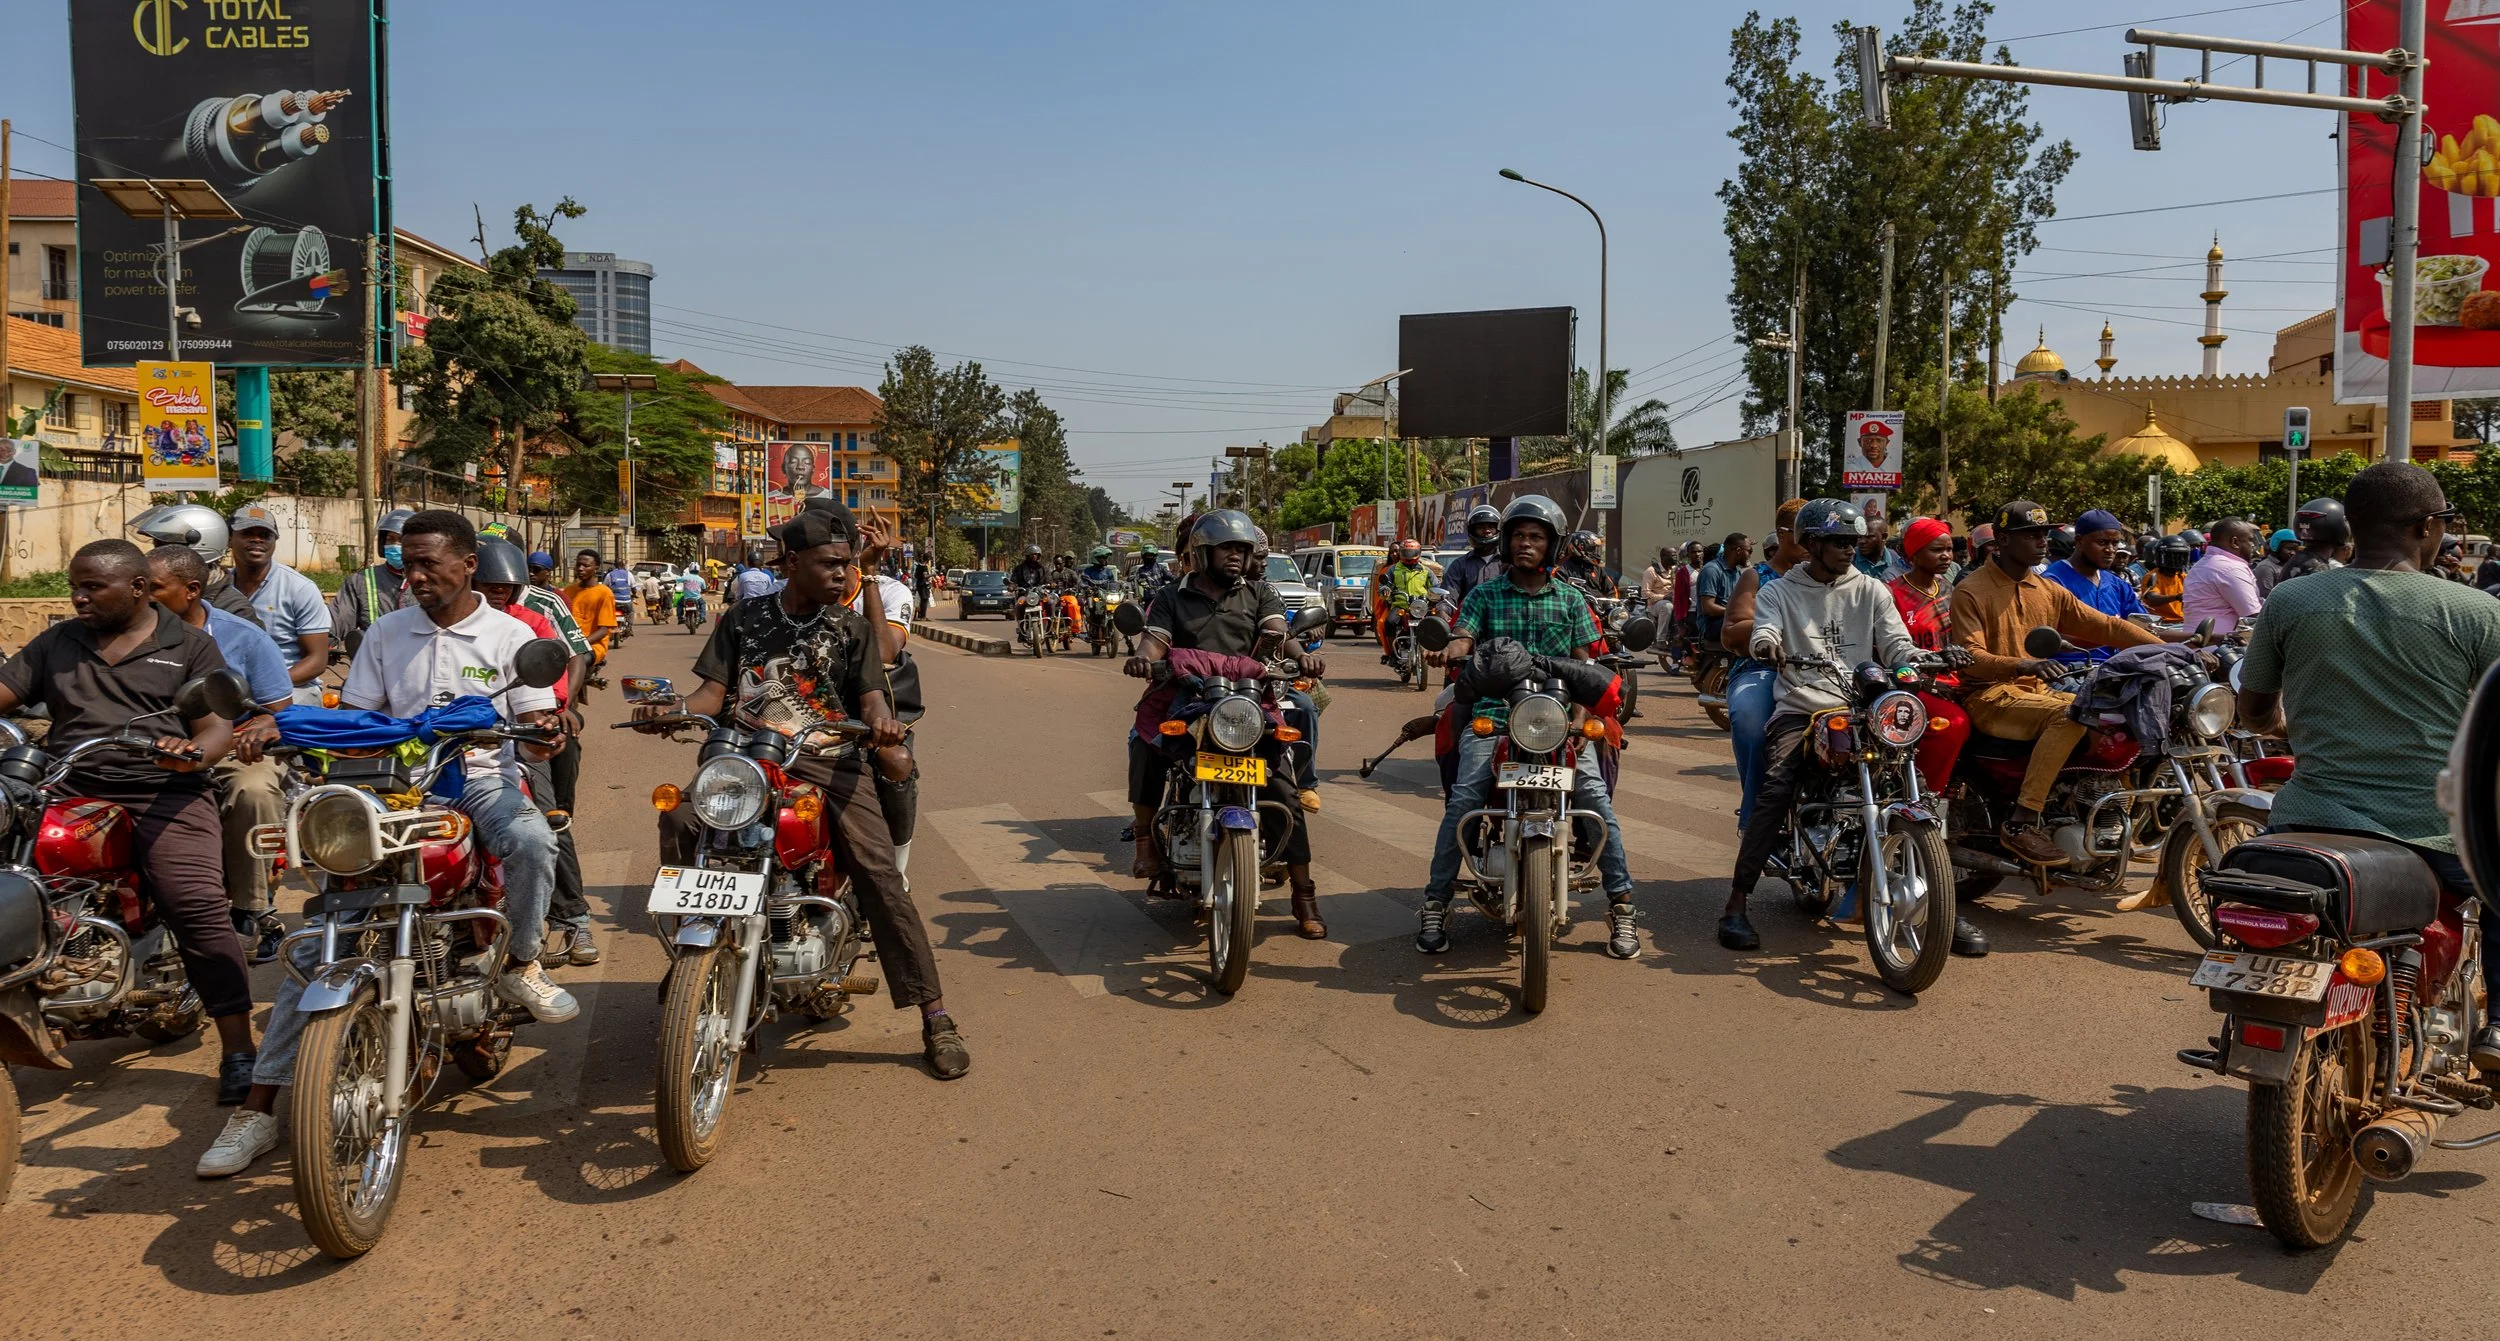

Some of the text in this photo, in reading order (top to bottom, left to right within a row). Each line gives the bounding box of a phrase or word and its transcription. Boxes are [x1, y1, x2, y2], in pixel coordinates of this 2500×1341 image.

[203, 0, 292, 20] TOTAL
[205, 26, 310, 48] CABLES
[589, 255, 611, 263] NDA
[104, 267, 121, 279] for
[104, 283, 201, 297] power trasfer.
[107, 340, 164, 350] 0756020129
[145, 386, 201, 407] Bikole
[165, 404, 208, 415] masavu
[1849, 412, 1865, 421] MP
[1848, 472, 1896, 481] NYANZI
[269, 504, 288, 515] FOR
[1667, 507, 1712, 528] RiiFFS
[1447, 520, 1465, 536] LOCS
[1672, 527, 1706, 537] PARFUMS
[1213, 763, 1257, 783] 229M
[1528, 765, 1563, 776] UFF
[1515, 776, 1562, 788] 643K
[696, 873, 737, 891] UMA
[676, 890, 748, 910] 318DJ
[2259, 922, 2287, 930] NZAGALA
[2224, 972, 2314, 997] 738P
